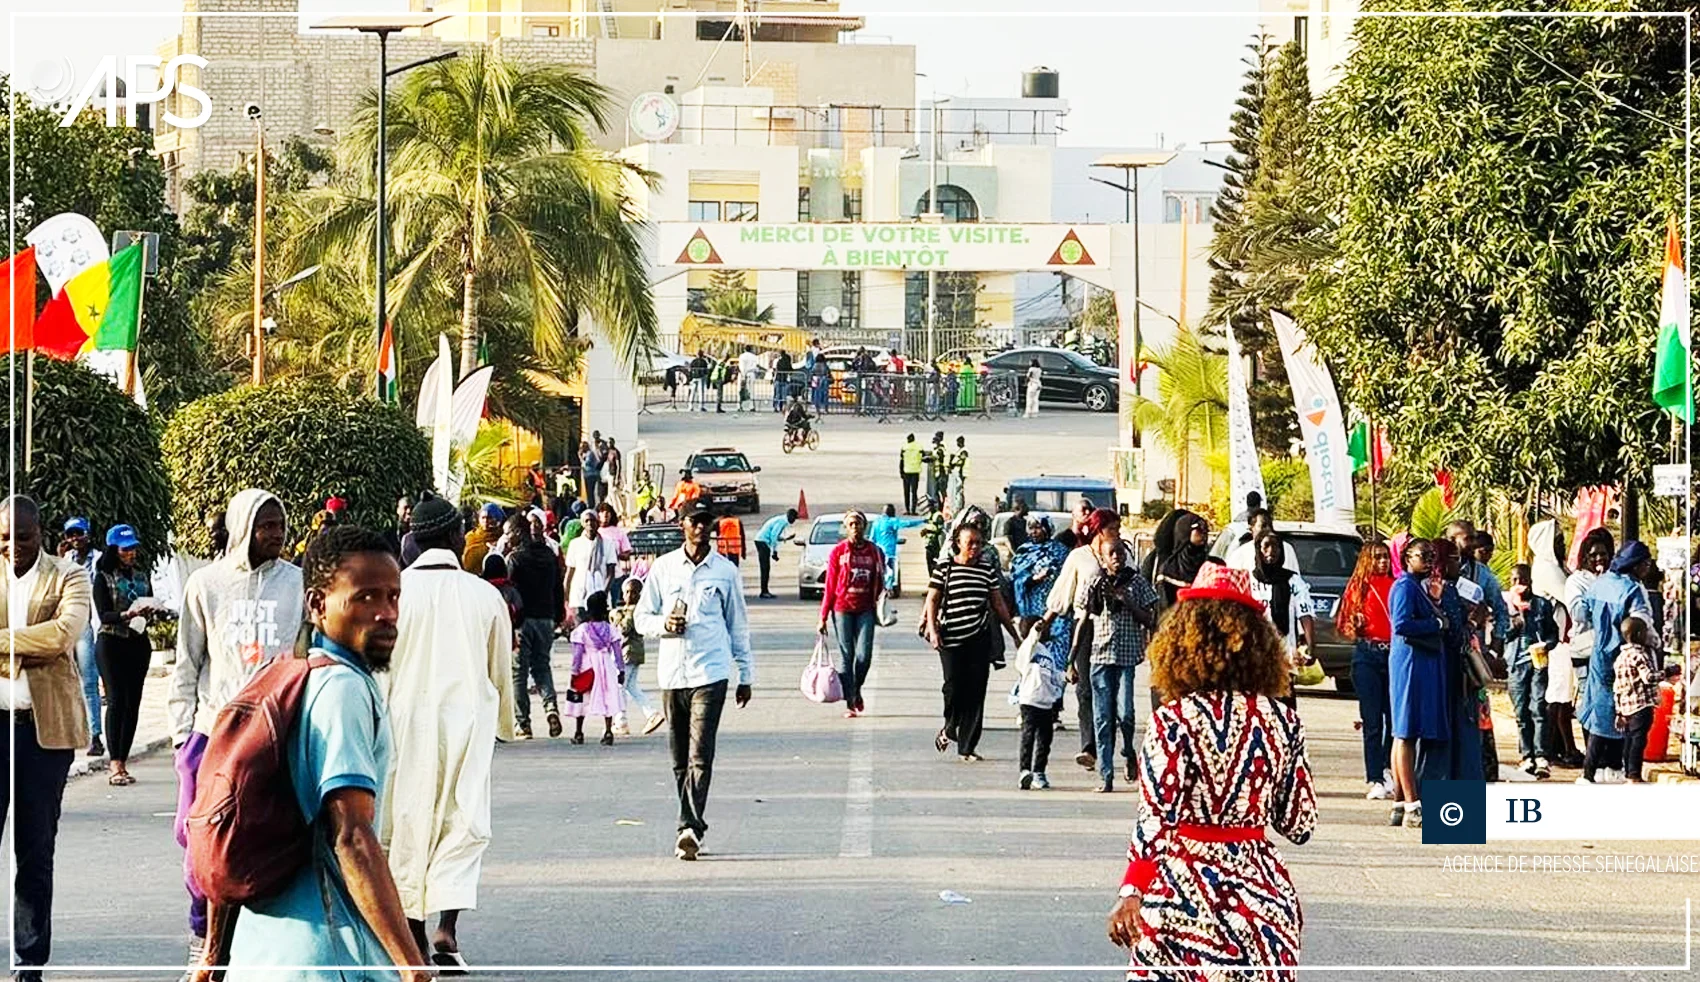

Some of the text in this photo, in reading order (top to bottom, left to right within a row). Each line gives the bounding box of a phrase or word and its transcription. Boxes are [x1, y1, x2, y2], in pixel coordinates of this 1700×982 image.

[740, 226, 1030, 244] MERCI DE VOTRE VISITE.
[821, 245, 950, 266] À BIENTÔT
[231, 599, 278, 623] JUST
[257, 622, 281, 646] IT.
